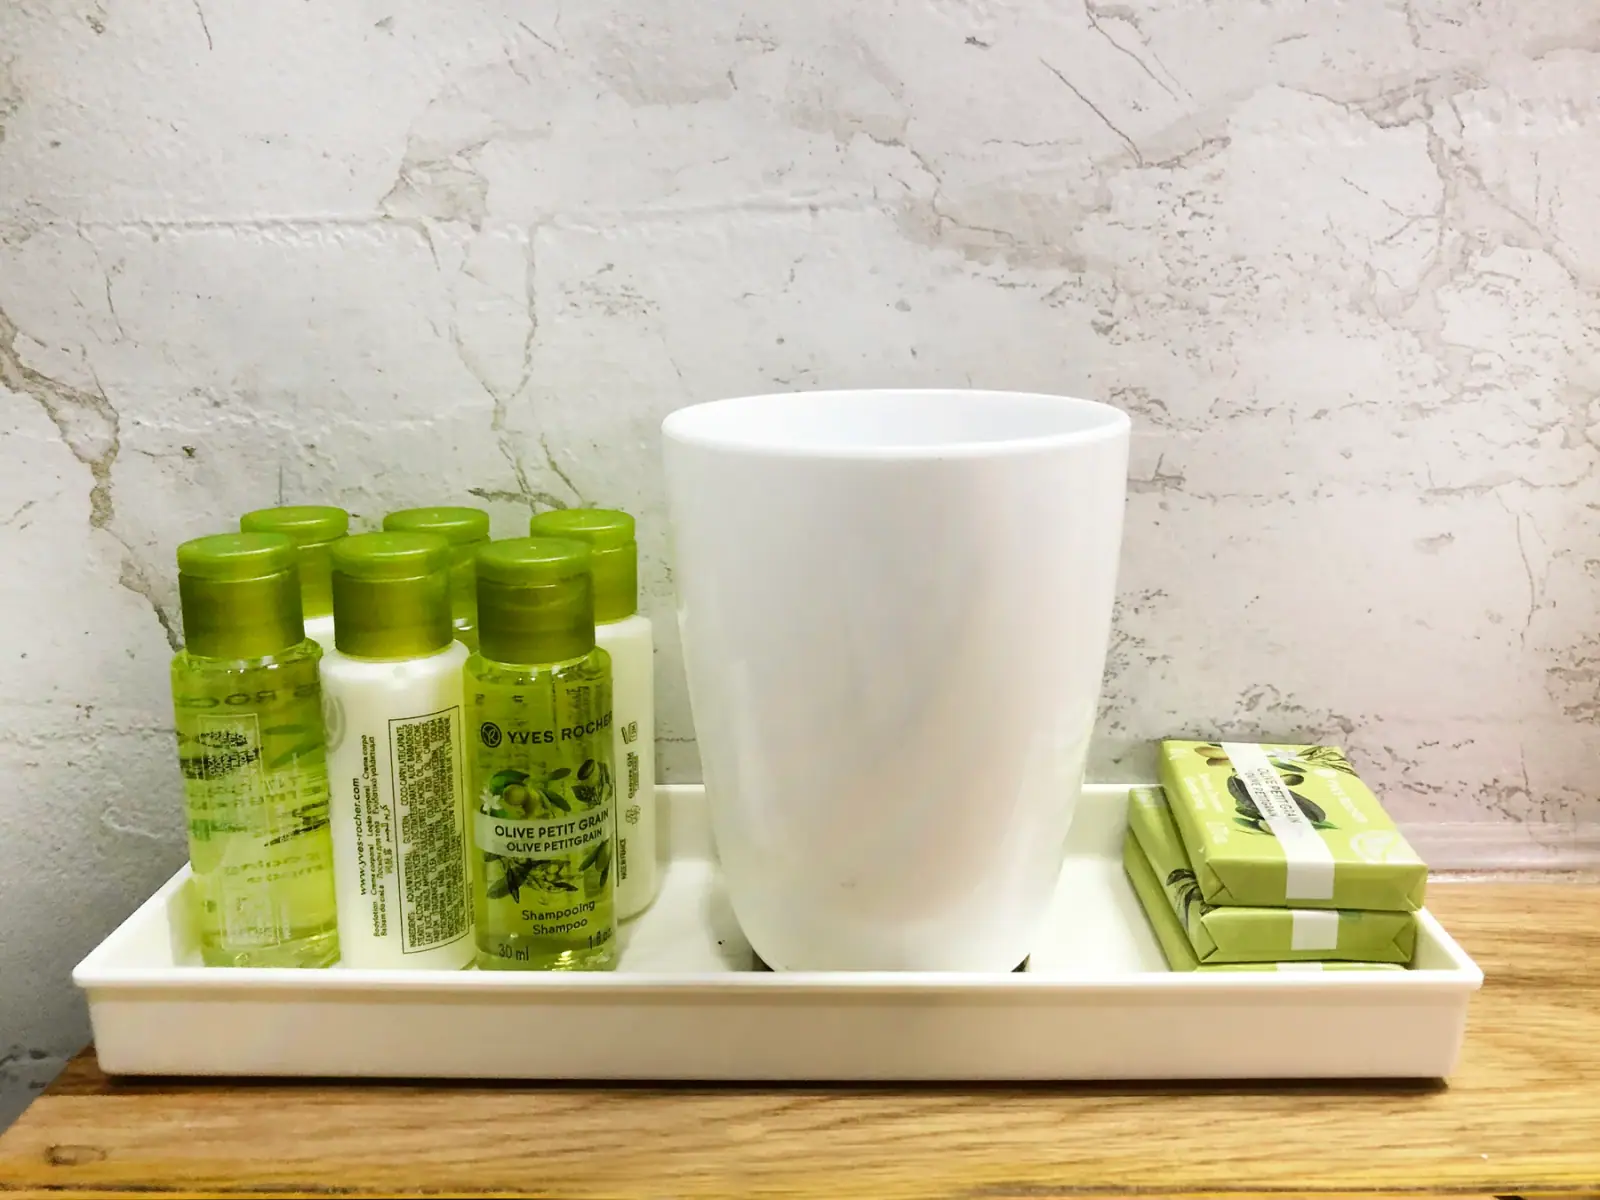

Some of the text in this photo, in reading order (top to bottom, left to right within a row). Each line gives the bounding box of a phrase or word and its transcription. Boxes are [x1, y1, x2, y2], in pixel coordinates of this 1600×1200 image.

[507, 731, 554, 744] YVES
[1257, 767, 1278, 785] OLIVE
[1270, 785, 1288, 804] PETIT
[495, 807, 609, 839] OLIVE PETIT GRAIN
[353, 777, 366, 896] www.yves-rocher.com
[506, 827, 602, 853] OLIVE PETITGRAIN
[522, 900, 595, 921] Shampooing
[533, 918, 588, 936] Shampoo
[498, 943, 529, 961] 30 ml
